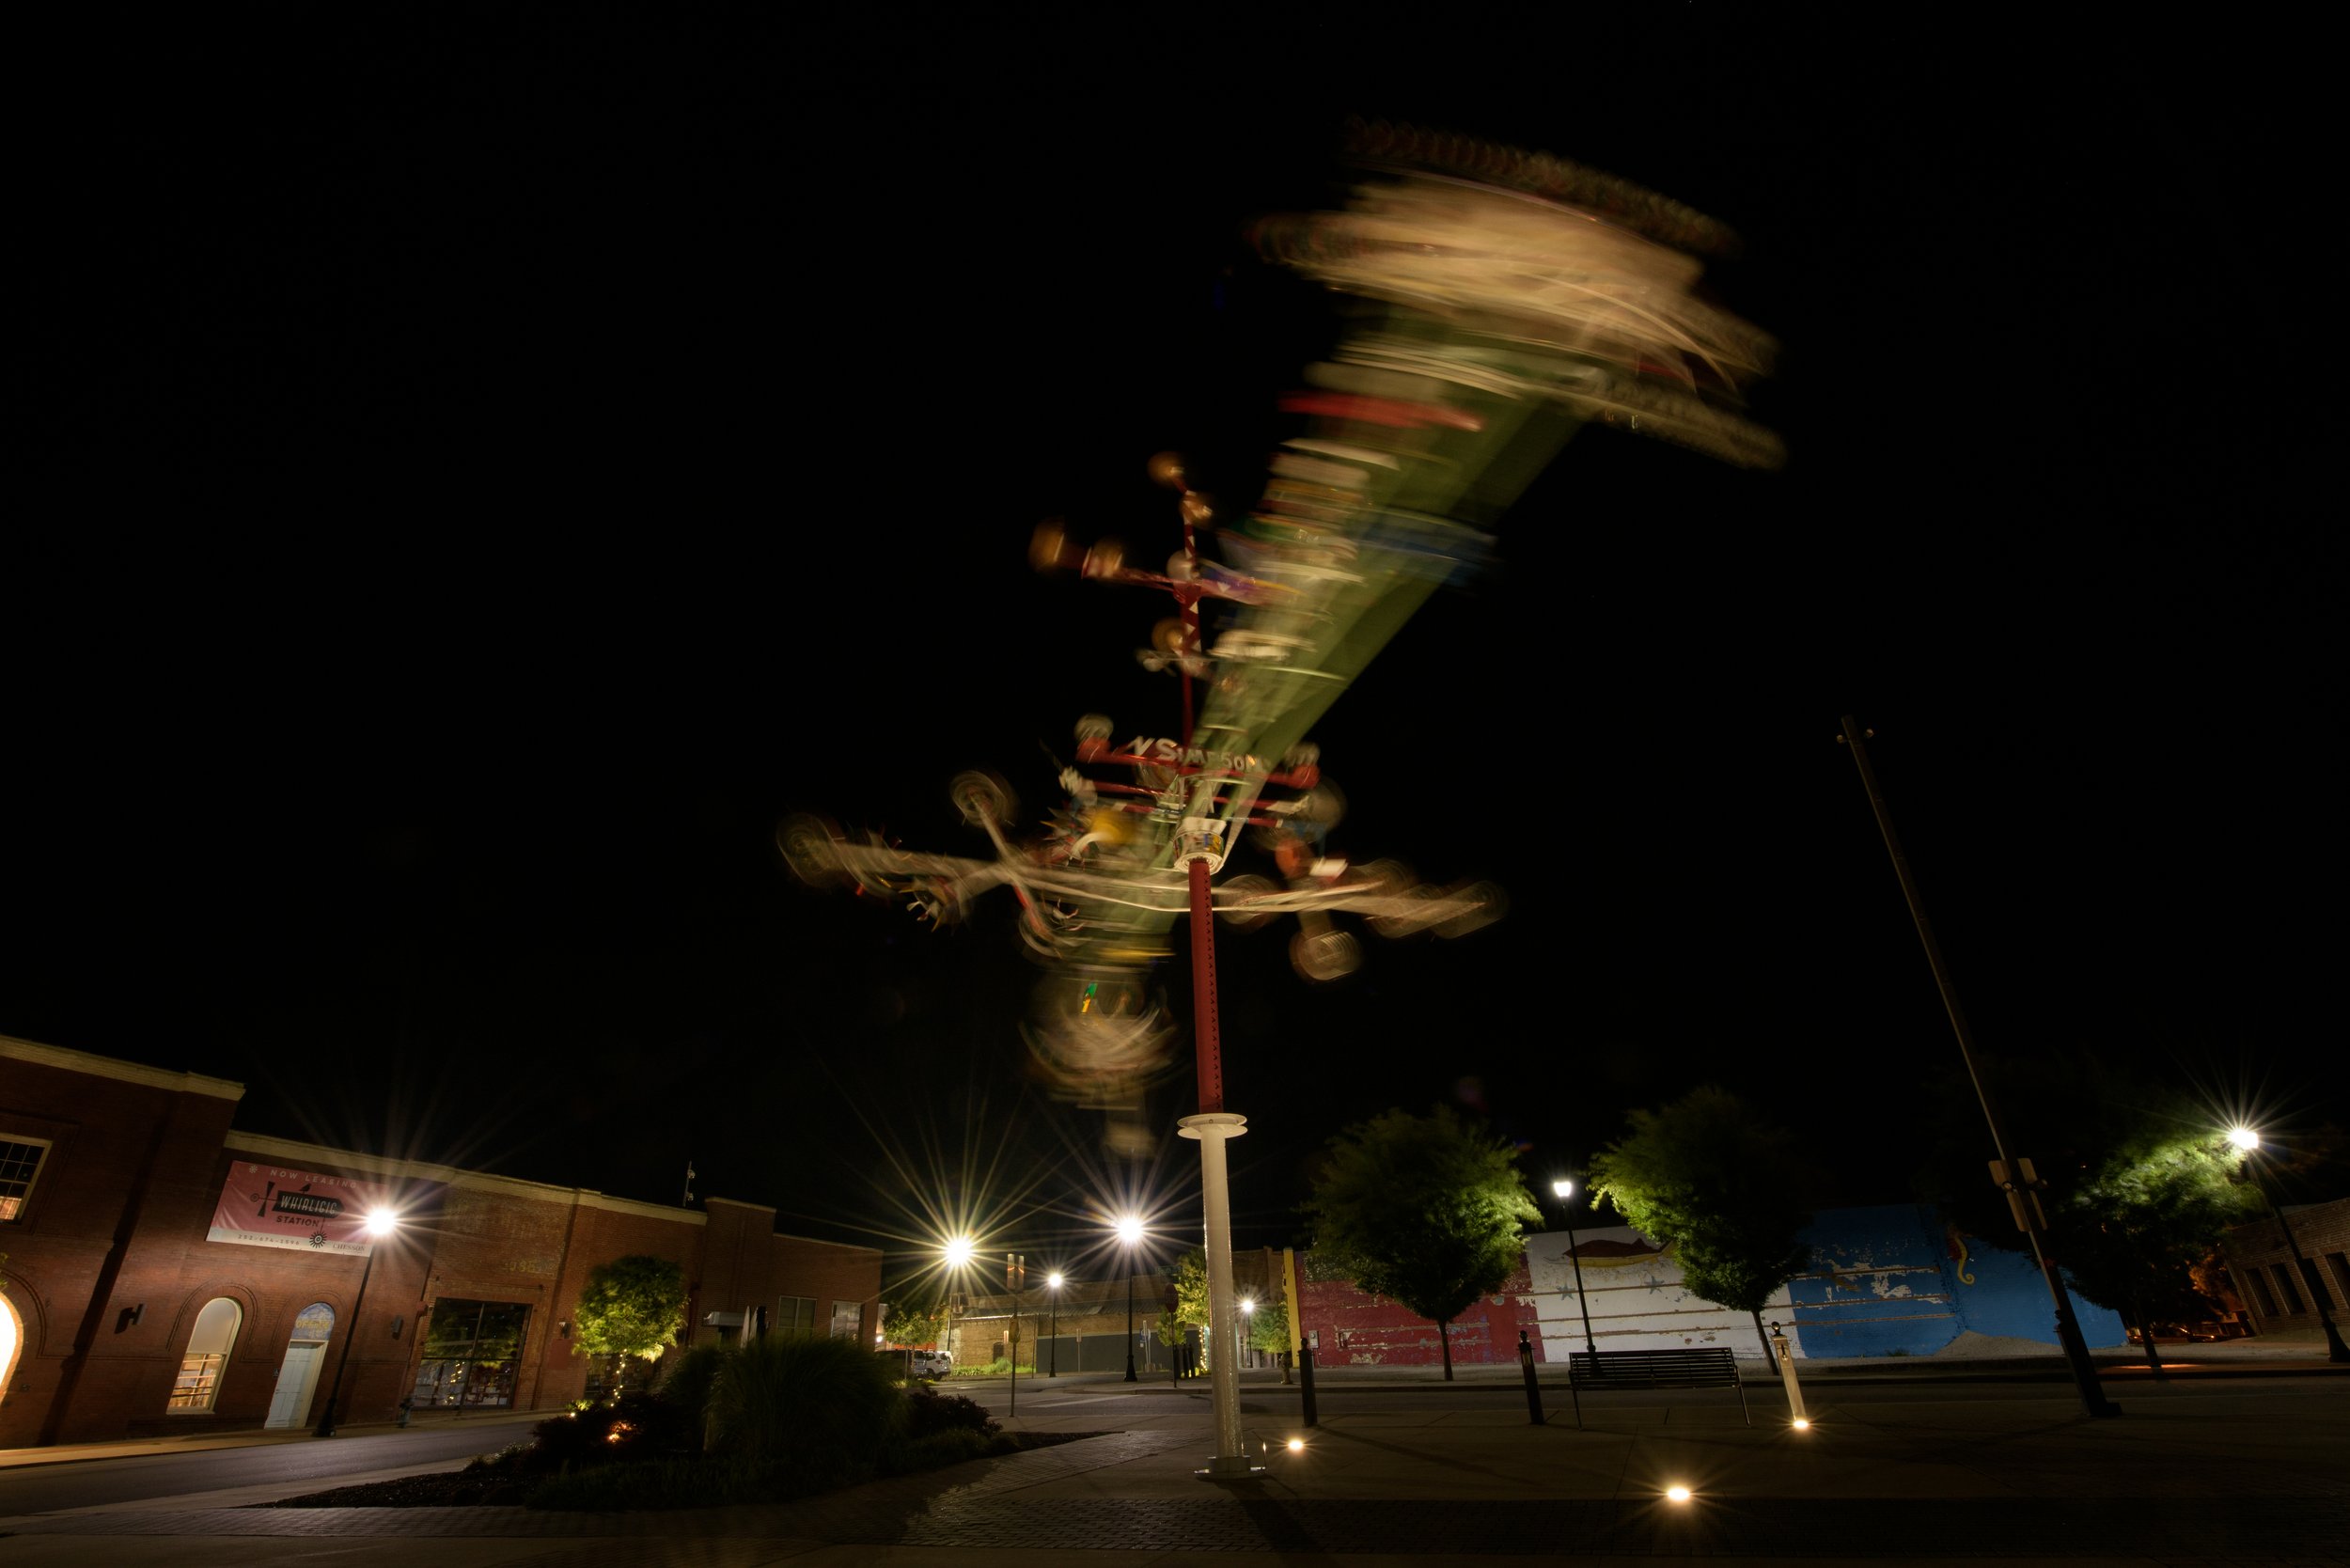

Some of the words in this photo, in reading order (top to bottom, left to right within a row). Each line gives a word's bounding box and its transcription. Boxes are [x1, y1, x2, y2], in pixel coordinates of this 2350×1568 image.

[270, 1169, 298, 1180] NOW
[305, 1174, 357, 1189] LEASING
[280, 1195, 338, 1215] WHIRLIGIG
[275, 1215, 321, 1228] STATION
